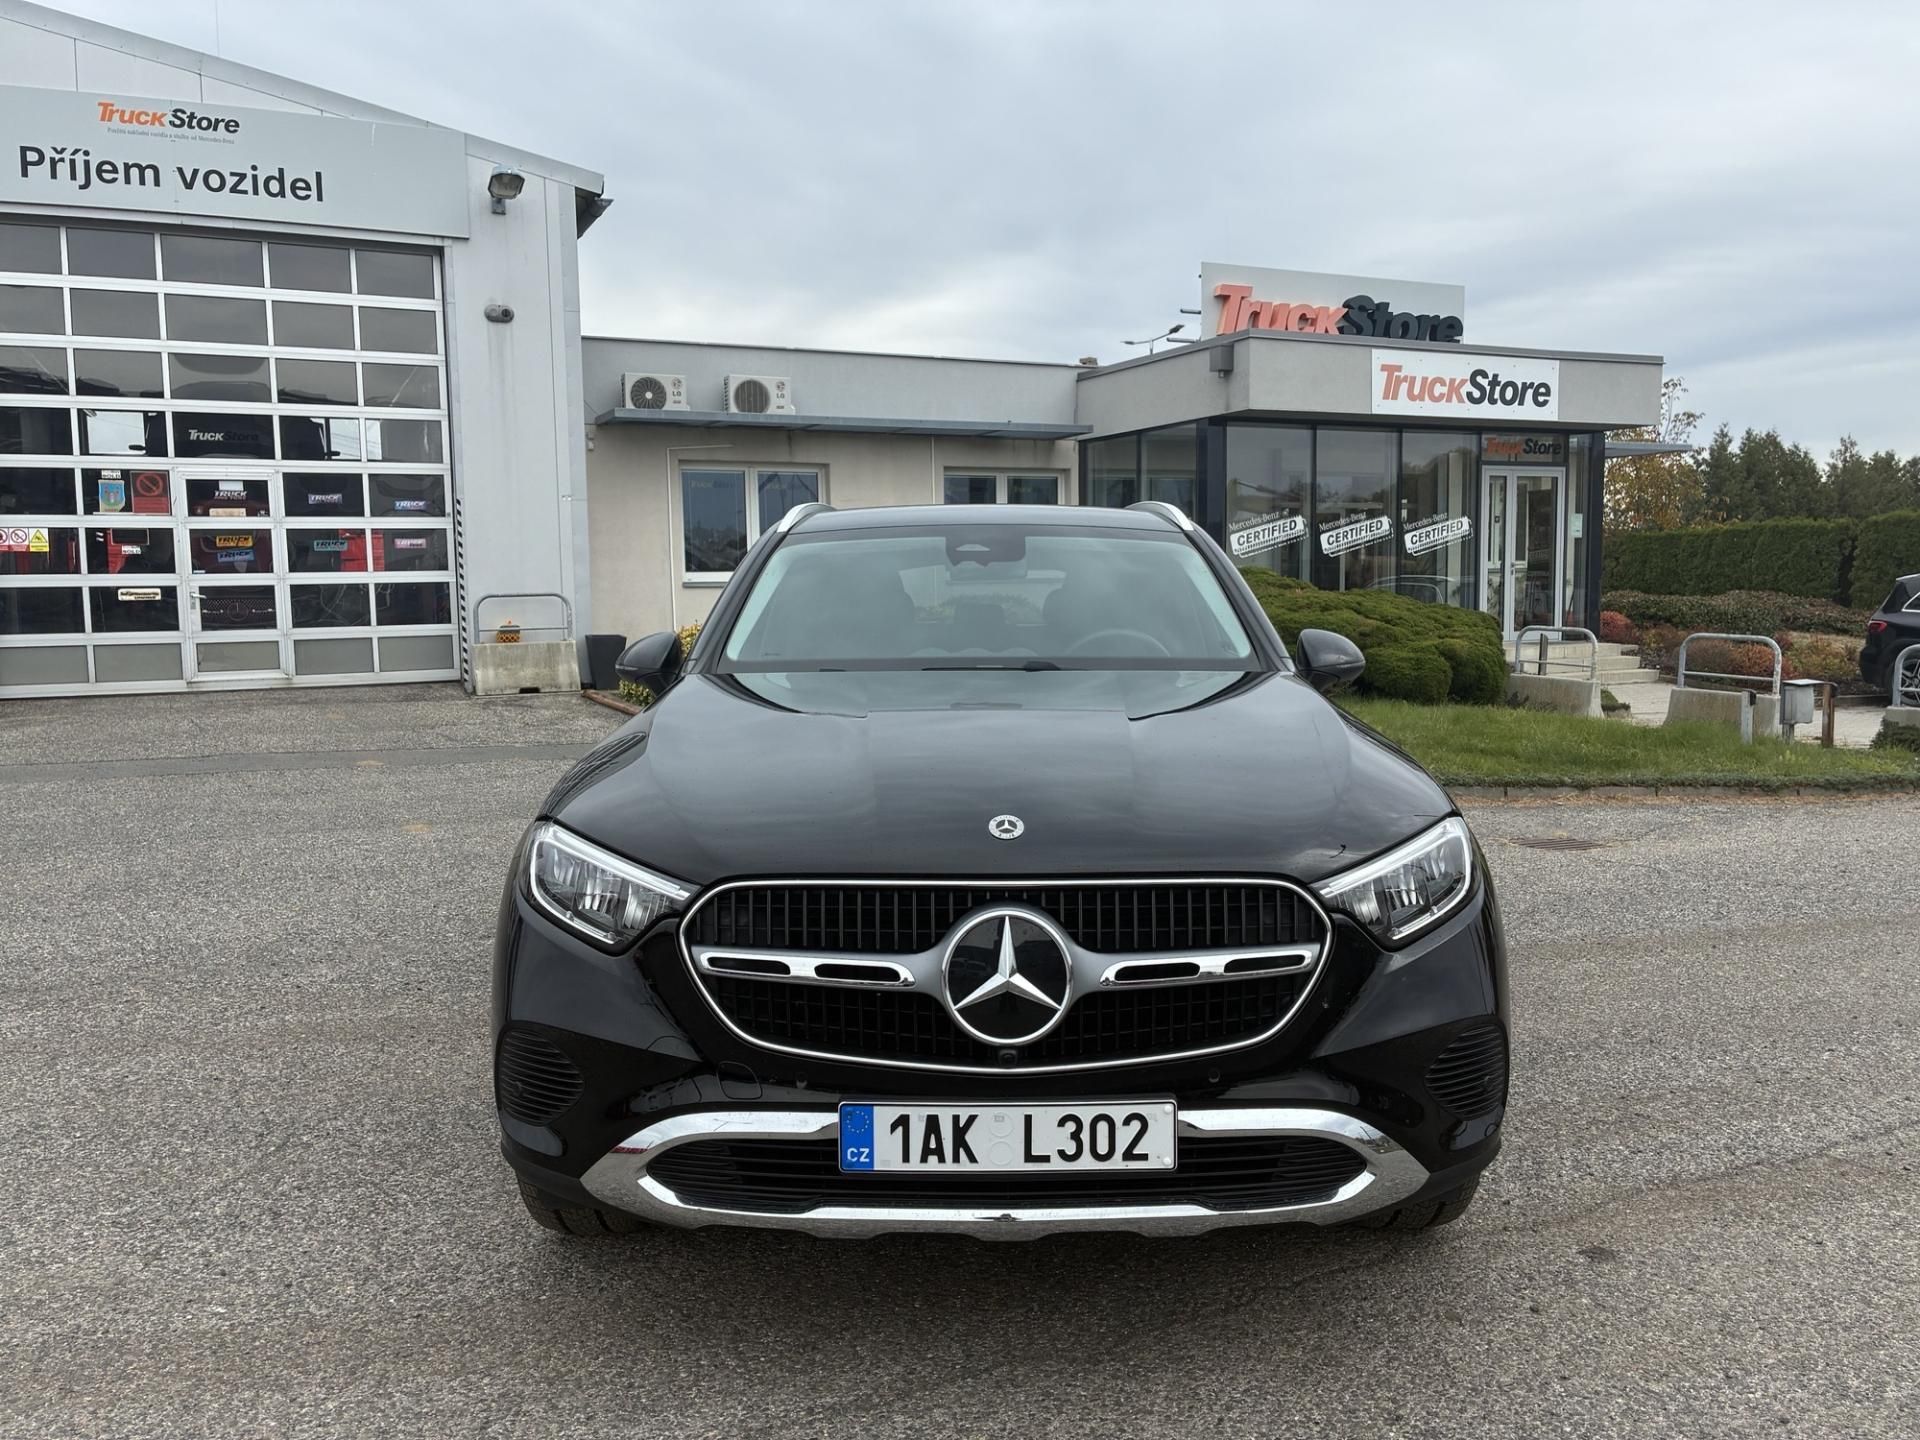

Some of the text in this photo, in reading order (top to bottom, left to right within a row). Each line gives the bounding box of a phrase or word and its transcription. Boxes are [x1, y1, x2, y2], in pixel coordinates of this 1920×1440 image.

[19, 145, 325, 202] Příjem vozidel
[1380, 363, 1552, 408] TruckStore
[1237, 519, 1297, 546] CERTIFIED
[1326, 519, 1383, 546] CERTIFIED
[1410, 520, 1463, 545] CERTIFIED
[890, 1112, 1150, 1164] 1AK L302
[847, 1147, 870, 1163] CZ
